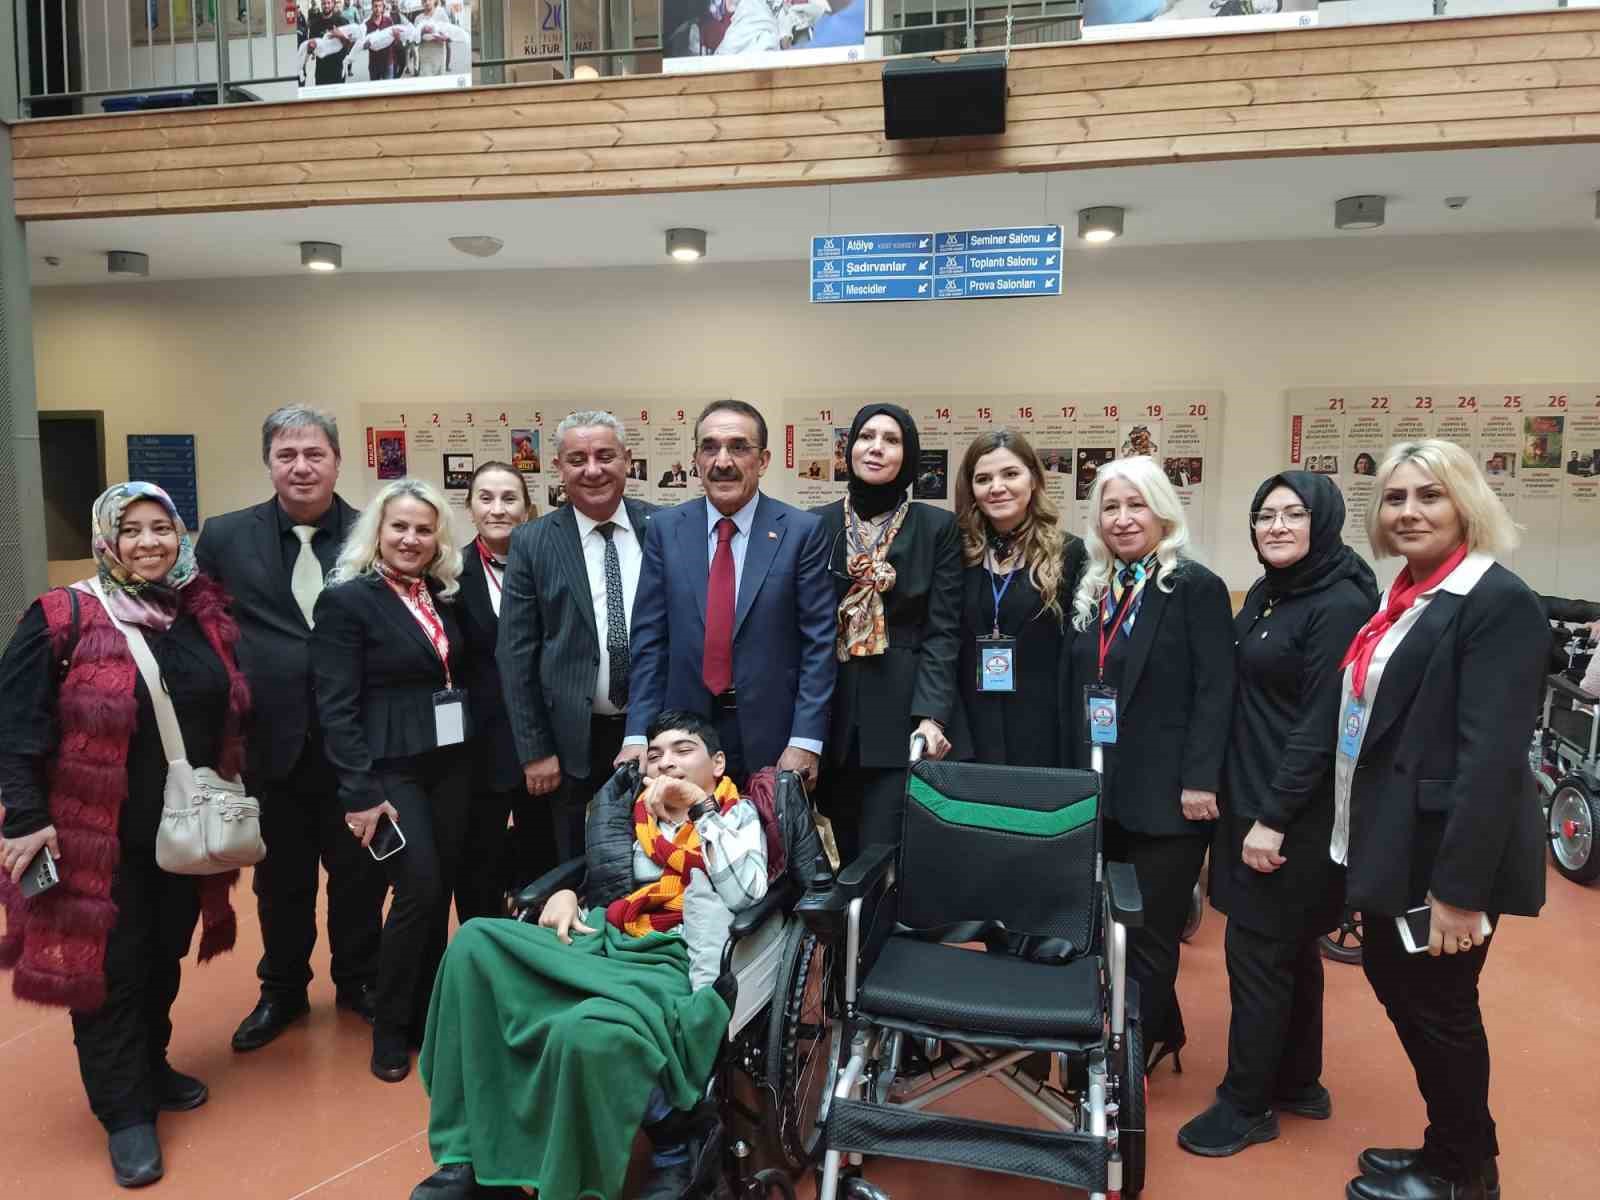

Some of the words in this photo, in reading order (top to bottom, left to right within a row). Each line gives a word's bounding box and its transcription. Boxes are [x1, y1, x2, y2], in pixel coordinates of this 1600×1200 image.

[970, 234, 1007, 246] Seminer
[1008, 232, 1041, 244] Salonu
[847, 239, 874, 252] Atölye
[846, 261, 907, 275] Şadırvanlar
[970, 256, 1005, 270] Toplantı
[1006, 254, 1038, 267] Salonu
[846, 283, 888, 295] Mescidler
[969, 280, 995, 291] Prova
[996, 277, 1036, 289] Salonları
[1329, 398, 1344, 410] 21
[1370, 396, 1389, 409] 22
[1415, 396, 1432, 409] 23
[1457, 396, 1476, 409] 24
[1503, 395, 1521, 408] 25
[1547, 395, 1567, 408] 26
[641, 410, 648, 421] 8
[677, 410, 684, 421] 9
[820, 410, 831, 421] 11
[935, 408, 950, 419] 14
[977, 407, 991, 419] 15
[1018, 406, 1032, 418] 16
[1062, 406, 1076, 418] 17
[1103, 405, 1118, 417] 18
[1146, 404, 1162, 417] 19
[1189, 404, 1207, 416] 20
[432, 412, 440, 424] 2
[465, 412, 473, 423] 3
[500, 412, 506, 422] 4
[535, 411, 542, 422] 5
